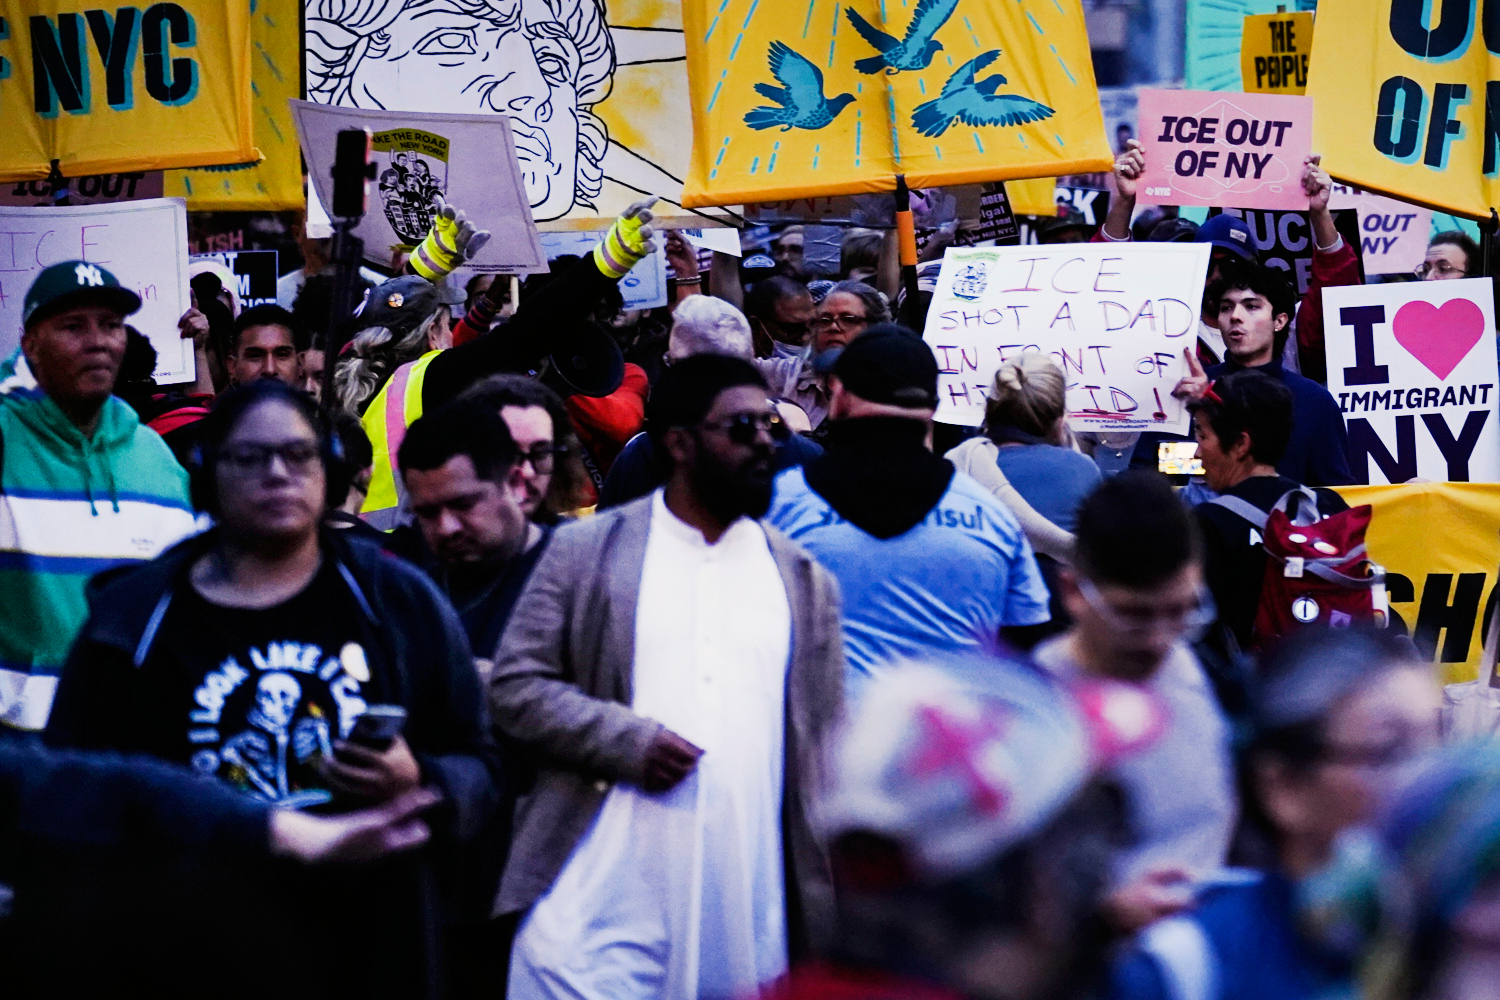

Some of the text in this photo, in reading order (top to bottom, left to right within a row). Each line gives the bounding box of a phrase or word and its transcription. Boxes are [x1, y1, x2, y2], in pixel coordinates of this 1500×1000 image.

[1268, 20, 1297, 54] THE
[29, 2, 200, 120] NYC
[1158, 116, 1293, 147] ICE OUT
[1373, 75, 1471, 172] OF
[371, 131, 448, 150] AKE THE ROAD
[400, 141, 446, 158] NEW YORK
[1174, 150, 1274, 179] OF NY
[1363, 213, 1418, 232] OUT
[1362, 237, 1399, 254] NY
[1001, 257, 1125, 294] ICE
[940, 298, 1193, 338] SHOT A DAD
[936, 345, 977, 374] IN
[997, 344, 1112, 375] FNT
[1339, 304, 1390, 387] I
[948, 382, 988, 406] HI
[1338, 383, 1493, 413] IMMIGRANT
[1346, 409, 1491, 486] NY
[189, 653, 250, 724] LOOK
[249, 639, 323, 674] LIKE
